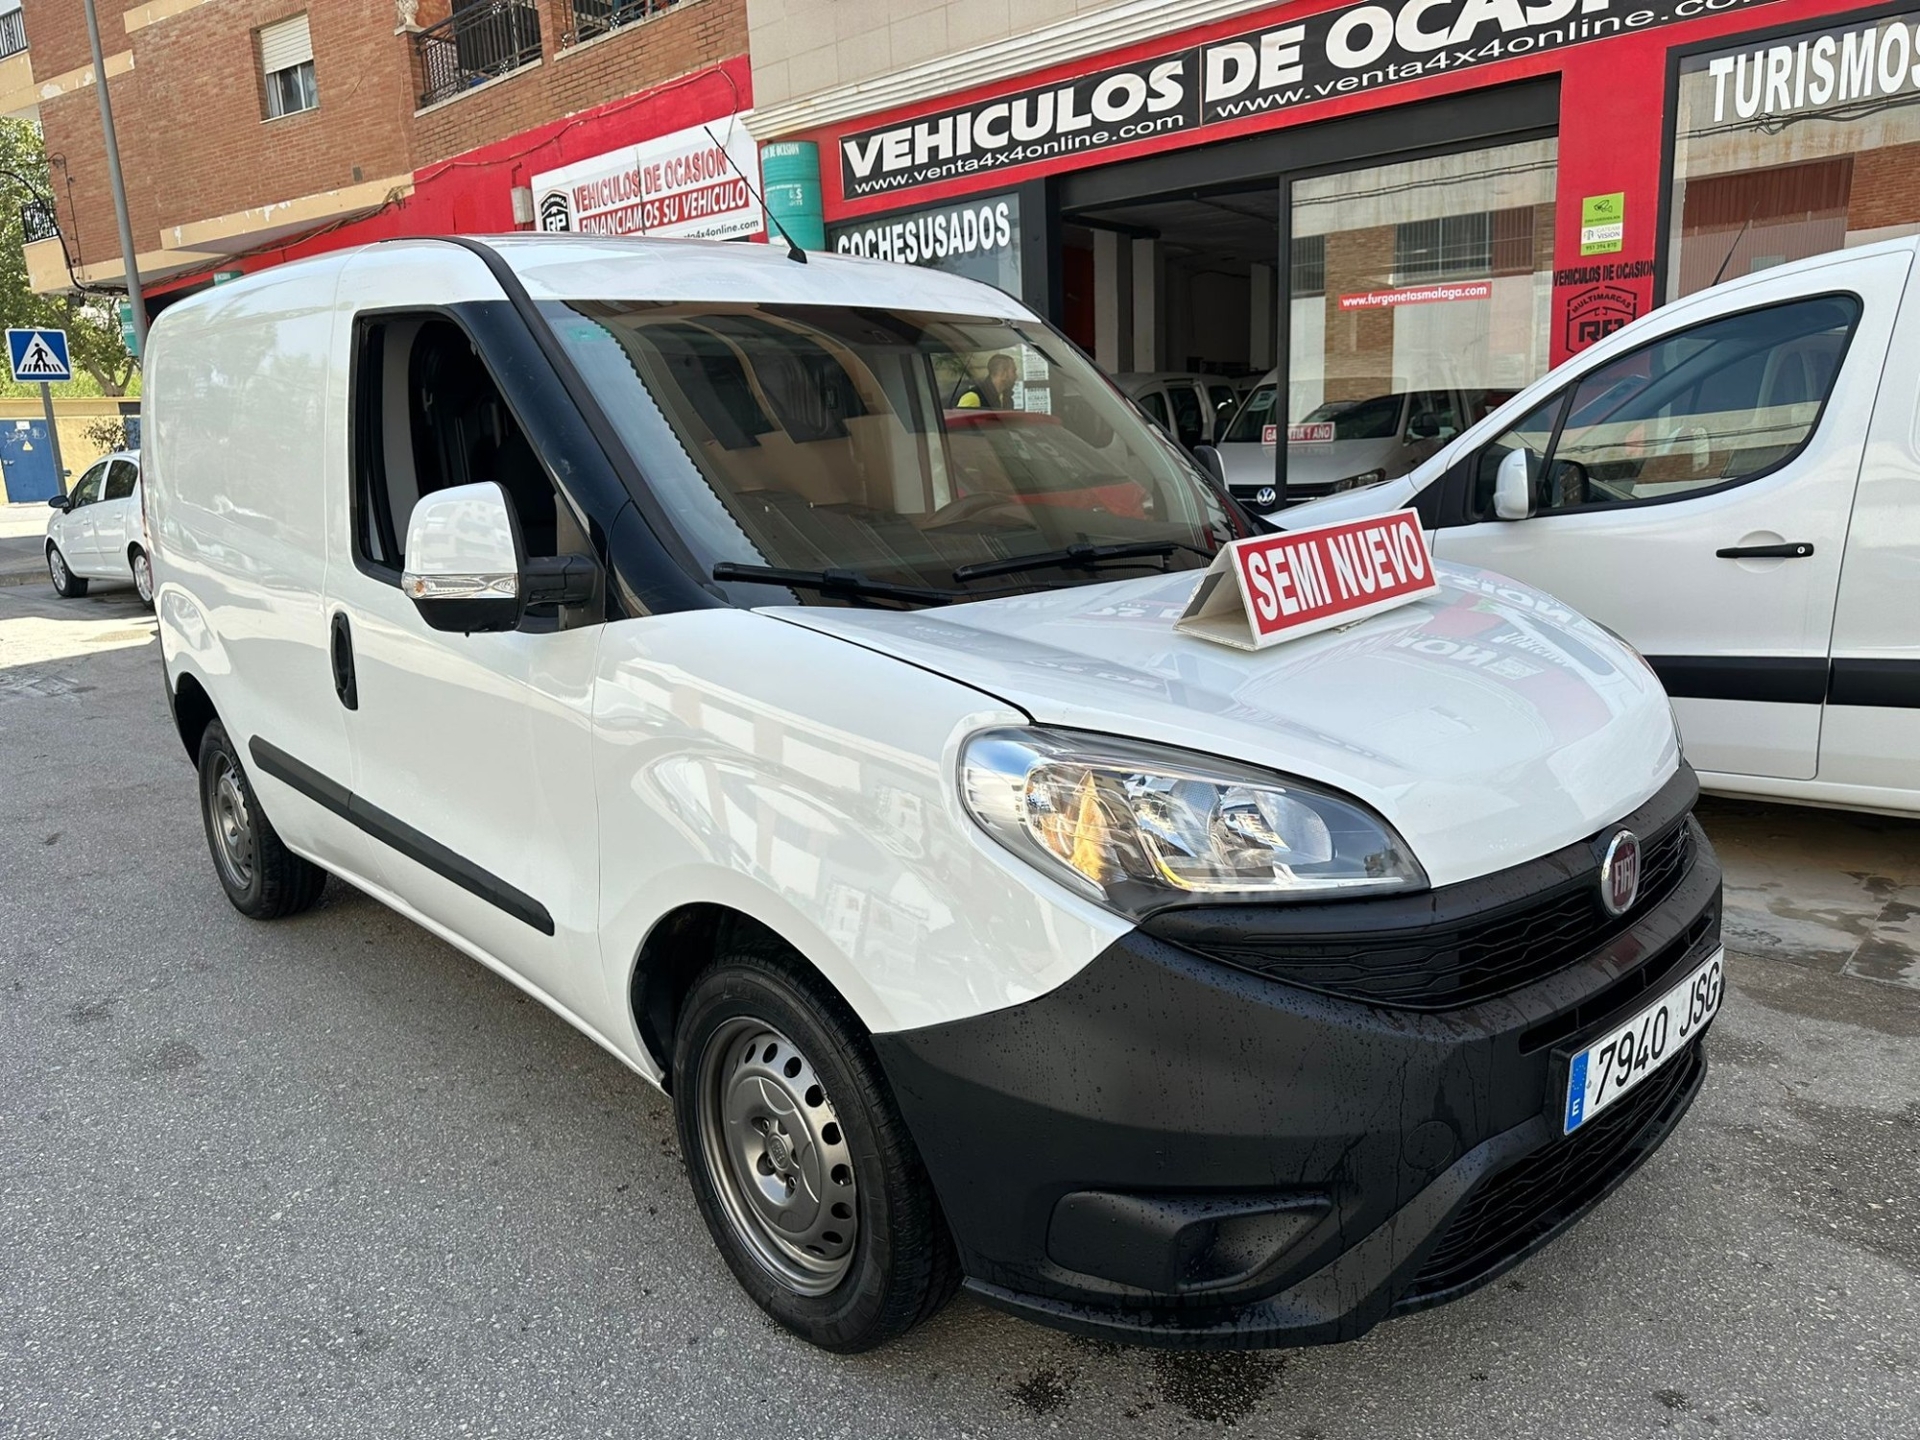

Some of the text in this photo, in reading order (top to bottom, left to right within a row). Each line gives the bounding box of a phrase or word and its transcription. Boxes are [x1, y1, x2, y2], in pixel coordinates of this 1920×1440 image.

[1216, 0, 1768, 118] www.venta4x4online.co
[843, 0, 1610, 178] VEHICULOS DE OCA
[572, 145, 728, 213] VEHICULOS DE OCASION
[854, 113, 1184, 194] www.venta4x4online.com
[663, 194, 680, 225] SU
[683, 181, 748, 218] VEHICULO
[1342, 286, 1488, 307] www.furgonetasmalaga.com
[1553, 259, 1655, 287] VEHICULOS DE OCASION
[1571, 293, 1631, 313] MULTIMARCAS
[1248, 521, 1425, 621] SEMI NUEVO
[1614, 854, 1634, 897] FIAT
[1594, 961, 1720, 1105] 7940 JSG
[1571, 1098, 1580, 1116] E
